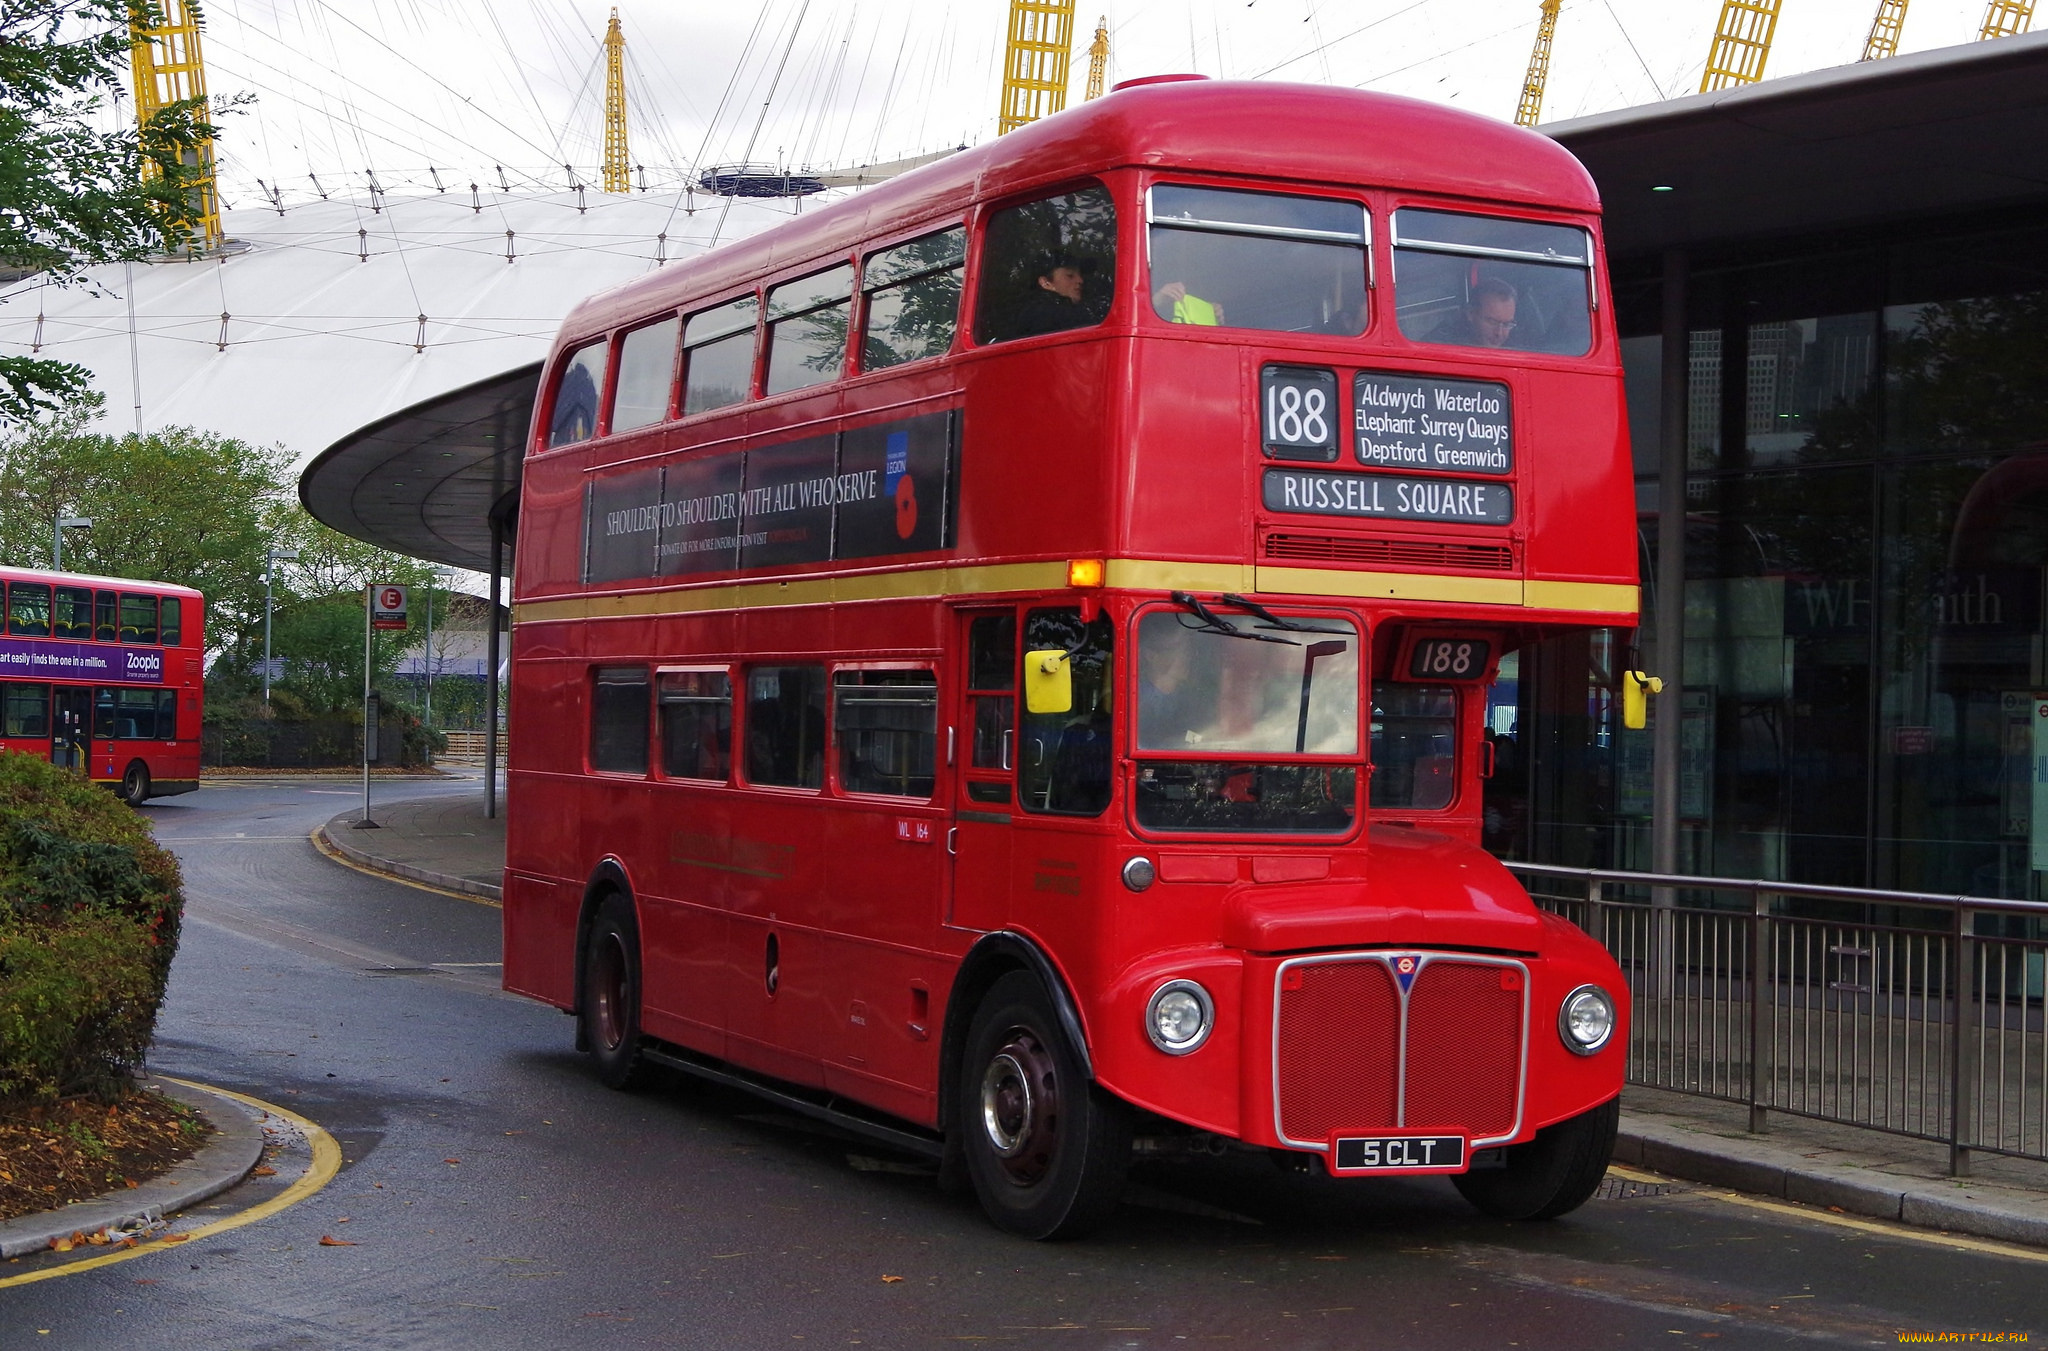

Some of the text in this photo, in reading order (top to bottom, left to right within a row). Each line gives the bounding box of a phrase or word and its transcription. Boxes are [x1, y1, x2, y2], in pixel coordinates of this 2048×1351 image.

[1268, 384, 1328, 444] 188
[1362, 383, 1499, 414] Aldwych Waterloo
[1355, 409, 1508, 445] Elephant Surrey Quays
[886, 459, 907, 475] LEGION
[1361, 437, 1506, 468] Deptford Greenwich
[606, 470, 877, 536] SHOULDER TO SHOULDER WITH ALL WHO SERVE
[1284, 476, 1486, 516] RUSSELL SQUARE
[752, 532, 768, 545] VISIT
[387, 591, 396, 606] E
[11, 652, 30, 666] easily
[31, 653, 48, 665] finds
[48, 653, 59, 665] the
[59, 656, 72, 666] one
[72, 655, 79, 667] in
[80, 658, 84, 667] a
[84, 656, 107, 668] million.
[127, 652, 160, 672] Zoopla
[1422, 642, 1472, 673] 188
[898, 821, 928, 839] WL 164
